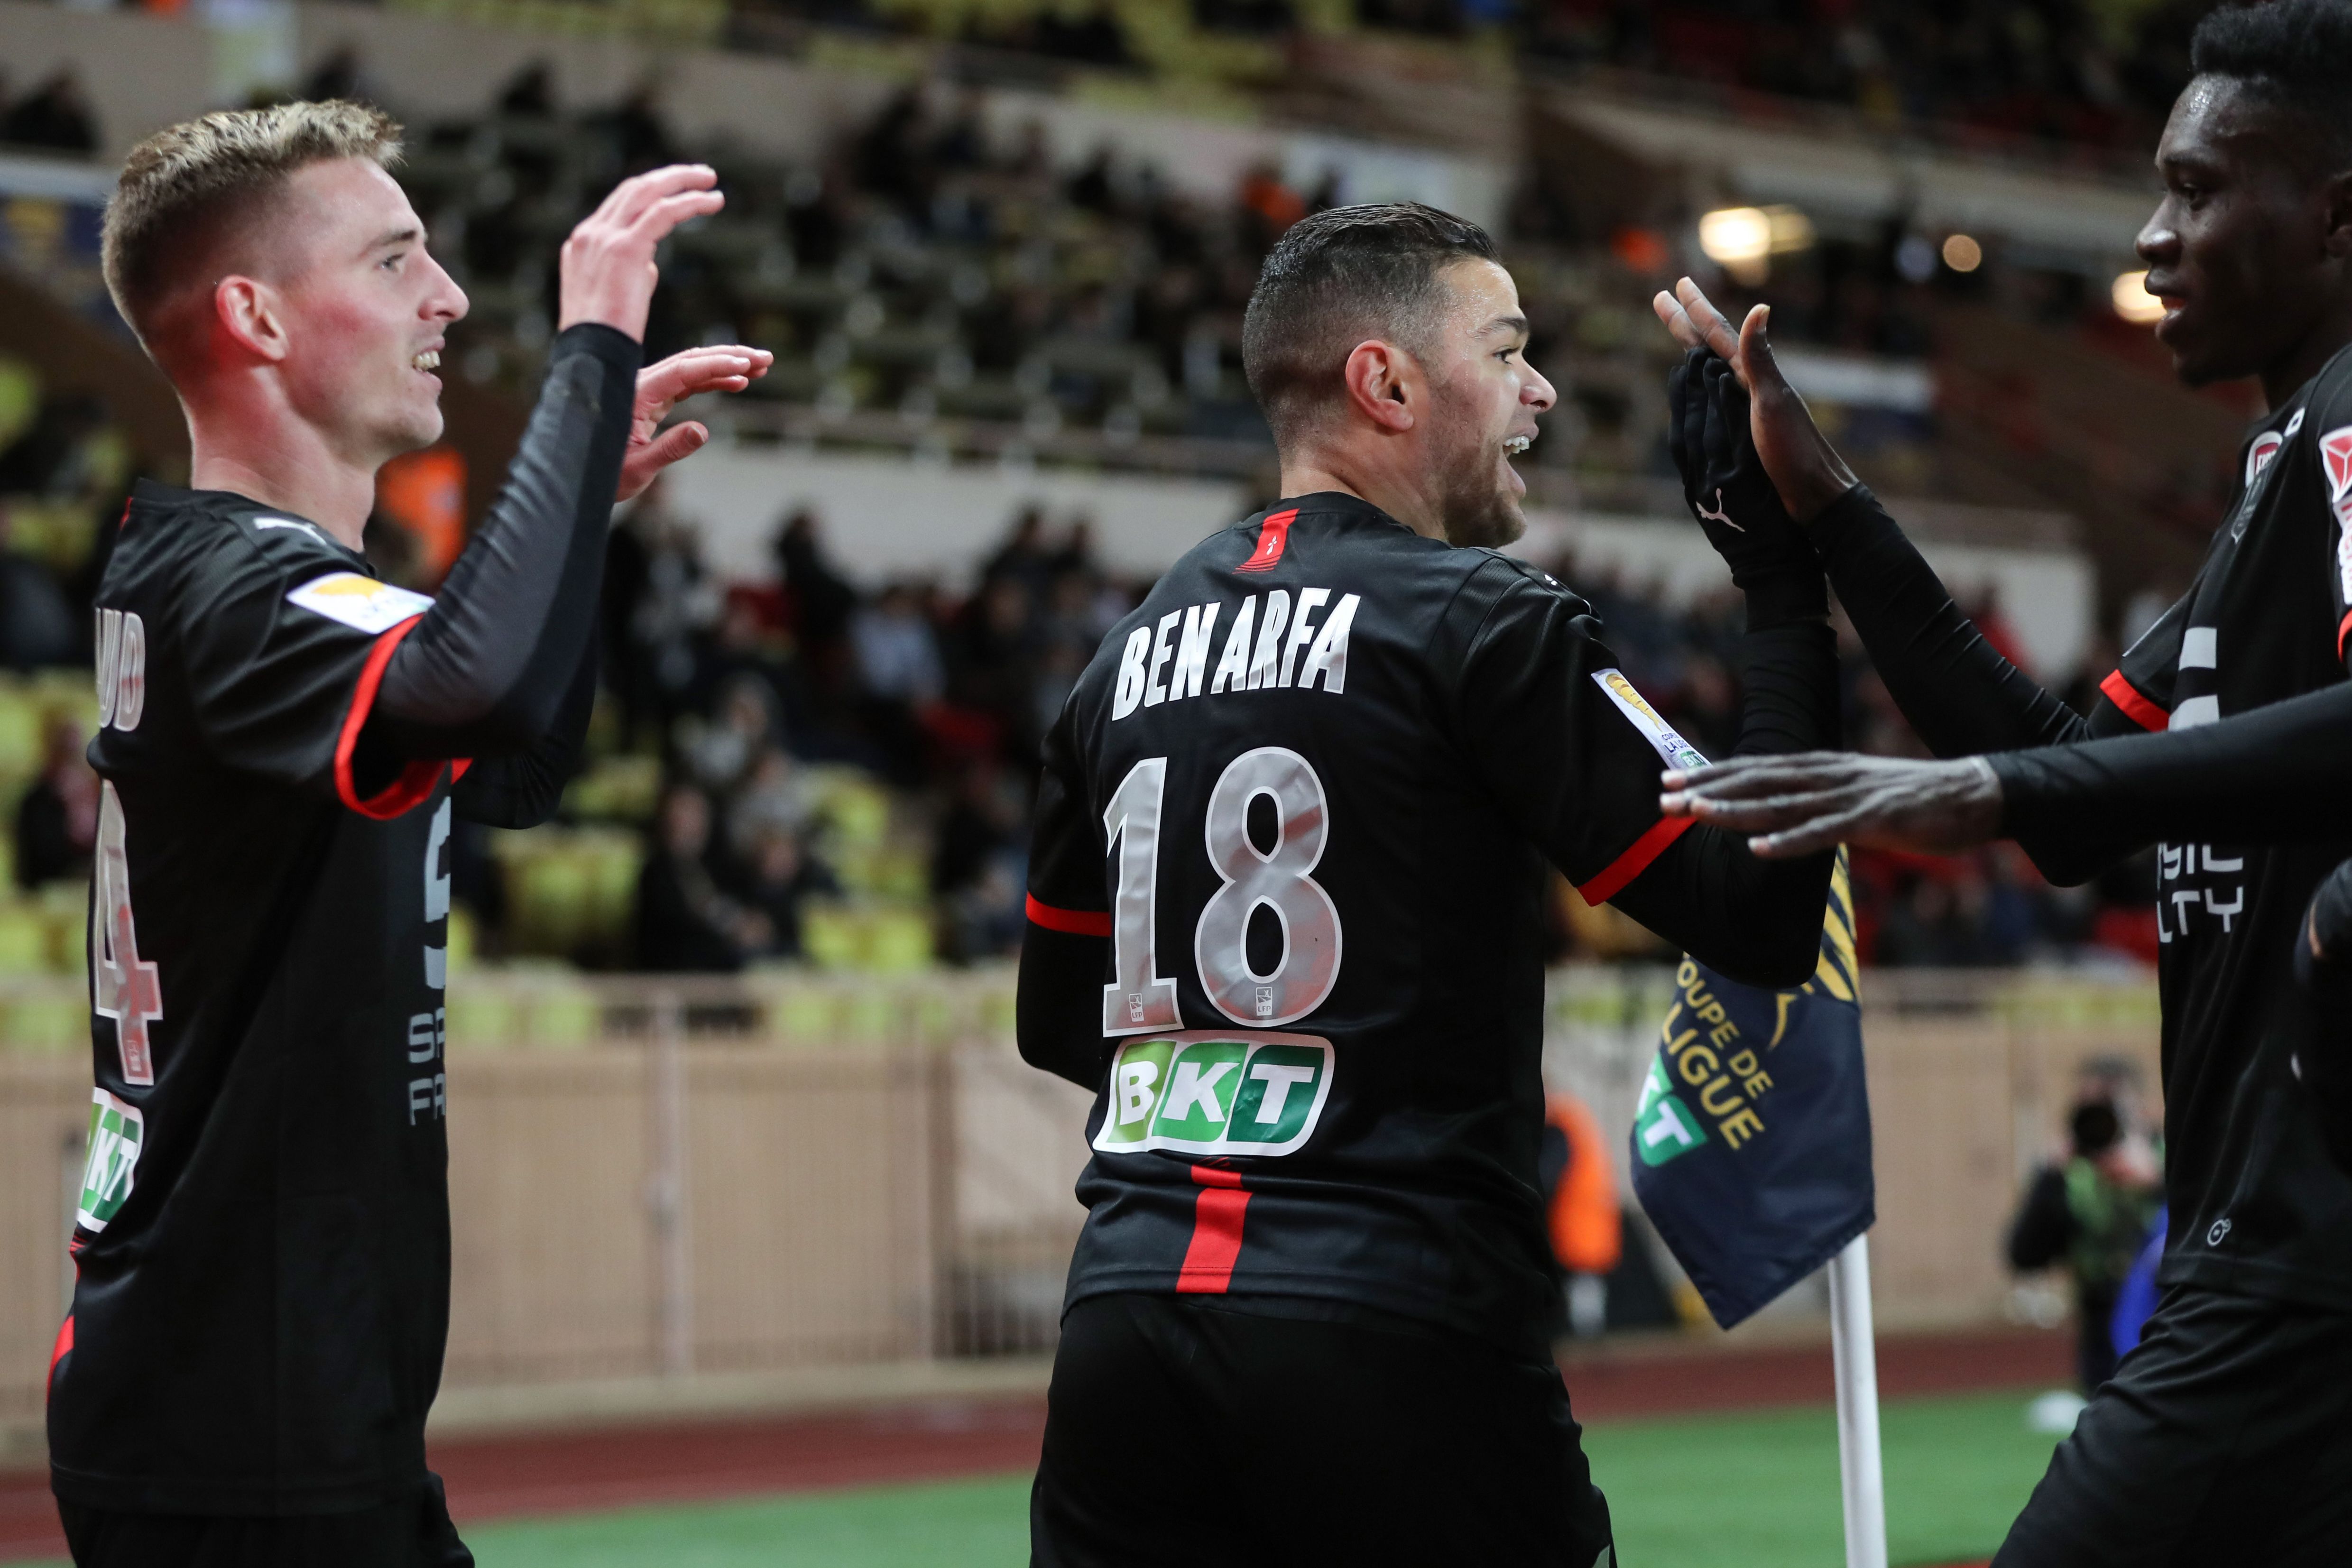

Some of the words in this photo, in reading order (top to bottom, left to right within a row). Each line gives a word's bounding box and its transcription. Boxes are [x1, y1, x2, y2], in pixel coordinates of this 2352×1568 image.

[95, 608, 145, 731] UD
[1112, 602, 1220, 721] BEN
[1211, 587, 1361, 695] ARFA
[1103, 746, 1342, 1038] 18
[1676, 951, 1740, 1051] OUPE
[1118, 1060, 1315, 1126] BKT
[1661, 1002, 1765, 1151] LIGUE
[1728, 1049, 1773, 1100] DE
[87, 1127, 138, 1202] KT
